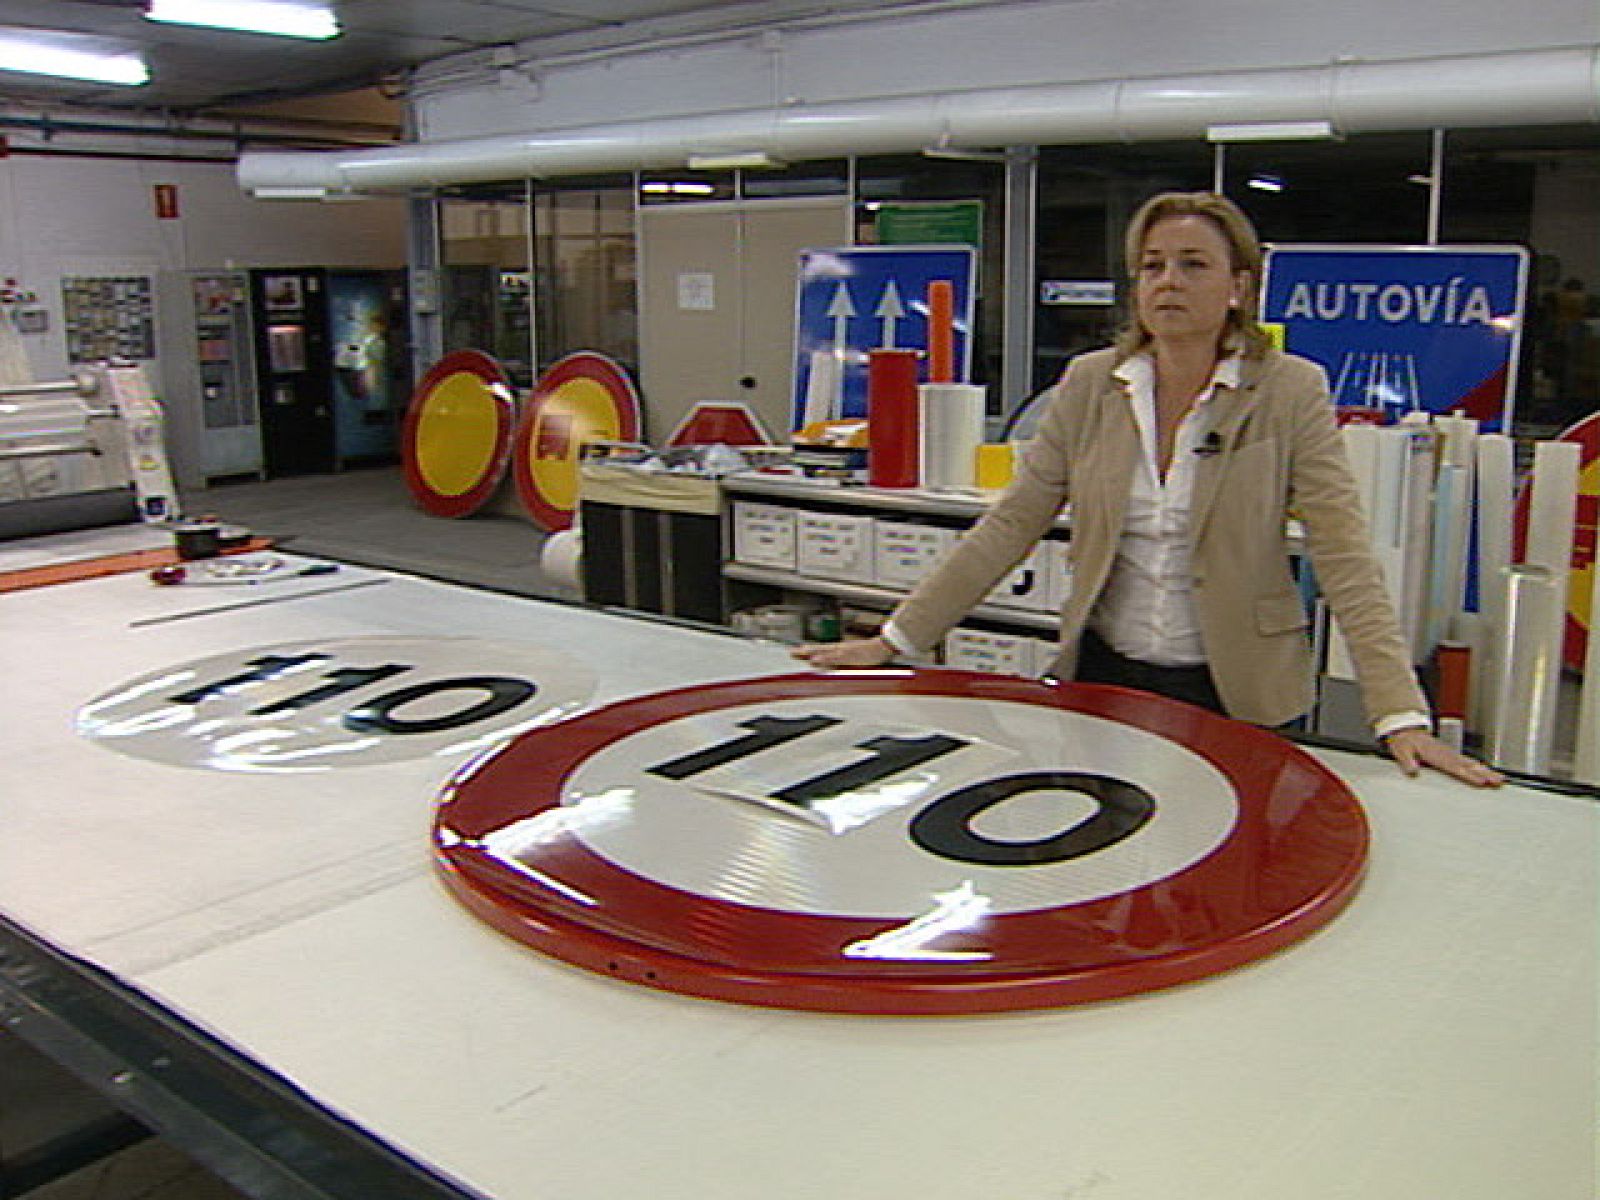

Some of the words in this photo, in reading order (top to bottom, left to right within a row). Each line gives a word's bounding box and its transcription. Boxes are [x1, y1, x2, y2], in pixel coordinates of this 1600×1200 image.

[1284, 276, 1491, 326] AUTOVÍA
[166, 652, 538, 735] 110
[644, 714, 1157, 867] 110
